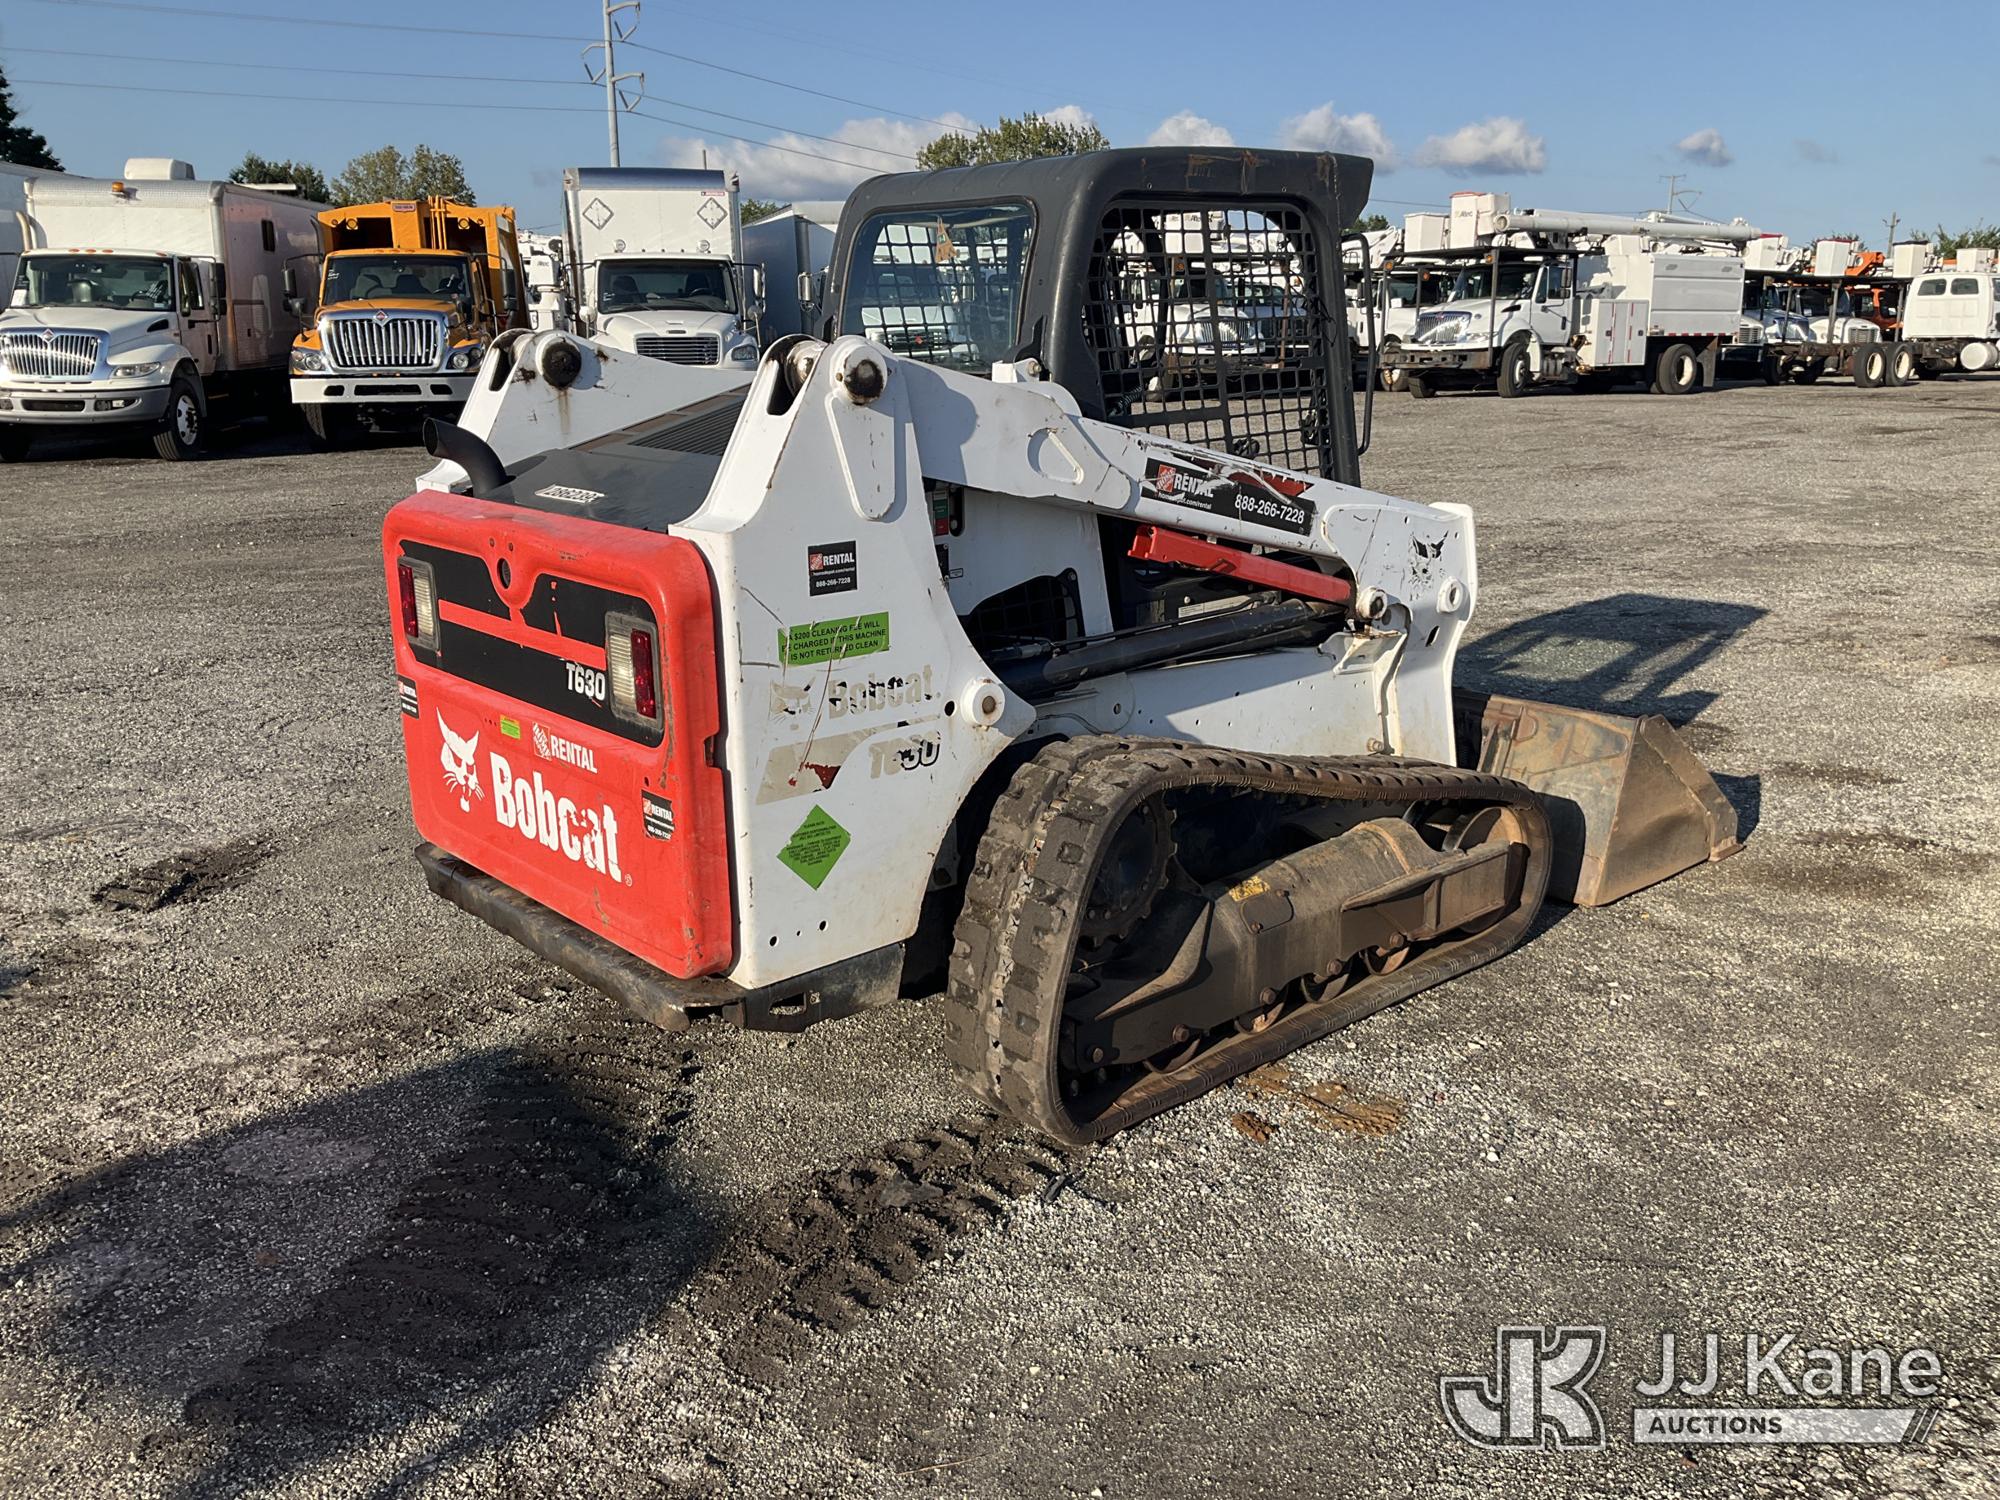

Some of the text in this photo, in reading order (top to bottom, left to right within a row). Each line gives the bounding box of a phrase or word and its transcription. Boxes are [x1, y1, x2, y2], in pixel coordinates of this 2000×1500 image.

[1234, 494, 1305, 525] 888-266-7228
[823, 552, 855, 566] RENTAL
[793, 638, 828, 650] CHARGED
[839, 634, 854, 644] THIS
[855, 628, 886, 641] MACHINE
[794, 631, 810, 641] $200
[811, 626, 848, 638] CLEANING
[864, 620, 880, 629] WILL
[790, 652, 798, 661] IS
[799, 650, 814, 660] NOT
[855, 640, 879, 650] CLEAN
[566, 662, 605, 700] T630
[828, 664, 934, 719] Bobcat
[551, 735, 597, 774] RENTAL
[490, 752, 622, 883] Bobcat
